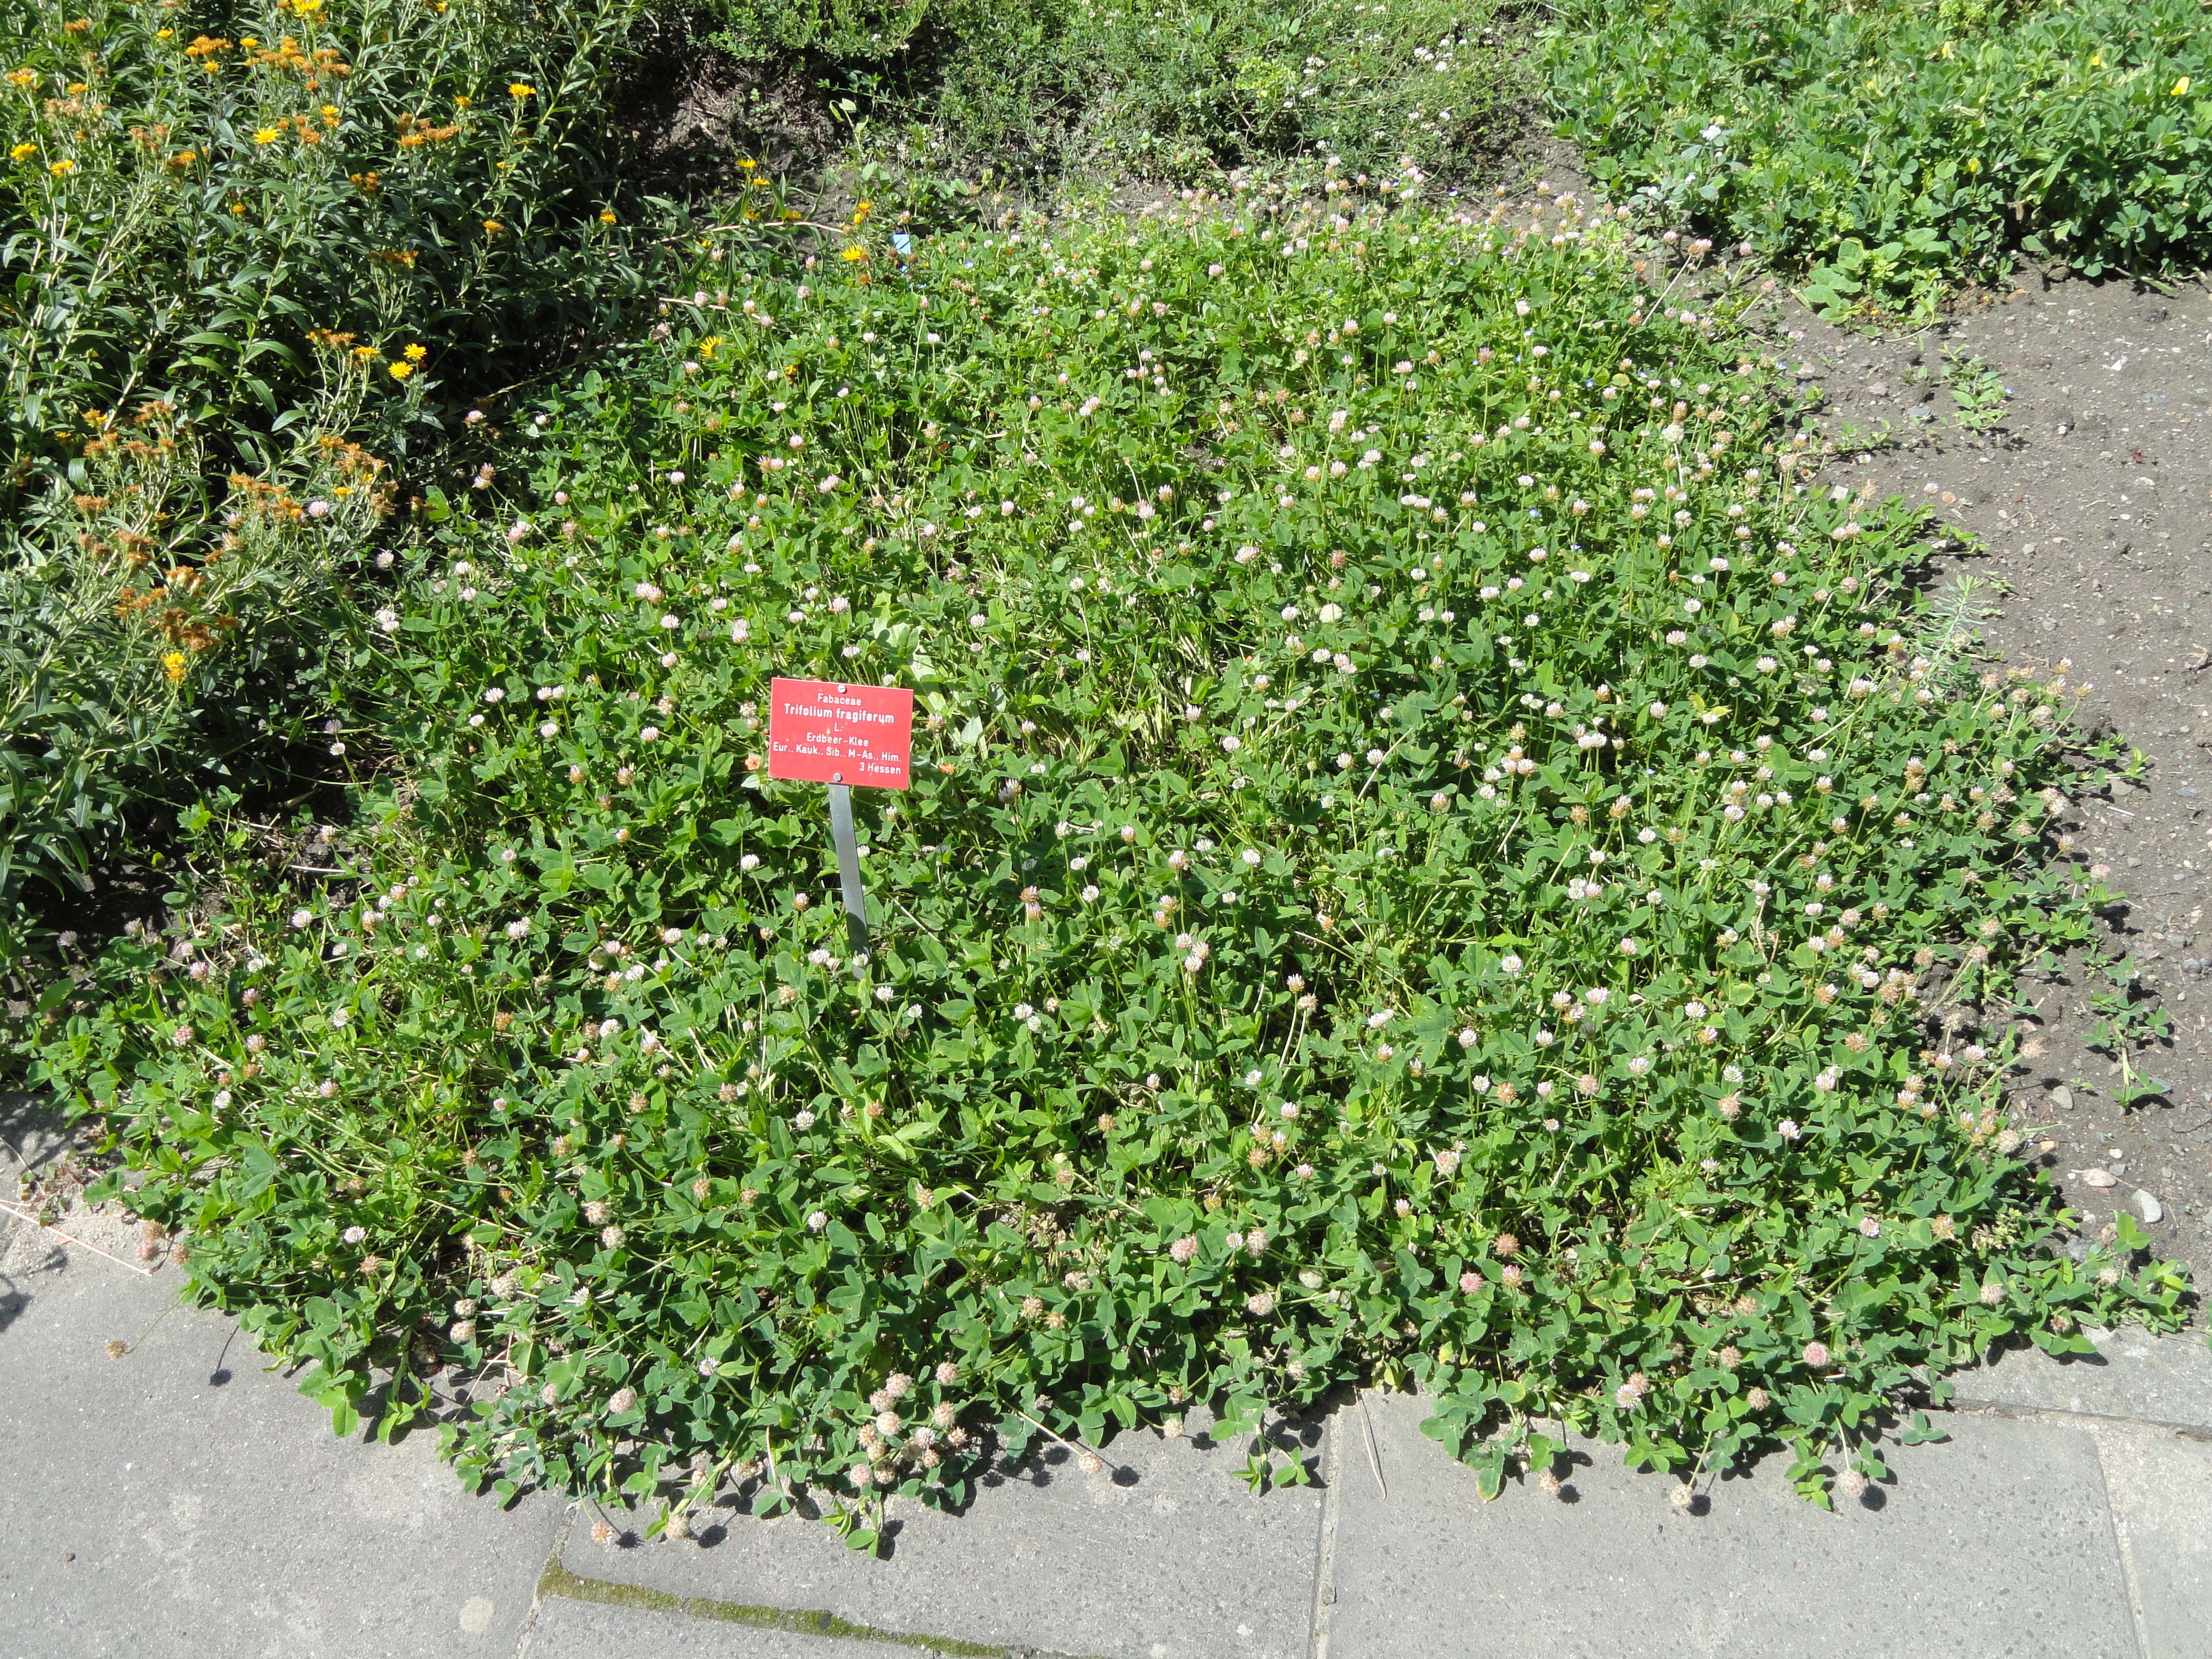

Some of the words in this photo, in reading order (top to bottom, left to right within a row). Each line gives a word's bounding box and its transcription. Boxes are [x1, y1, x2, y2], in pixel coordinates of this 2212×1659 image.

[818, 693, 861, 706] Fabaceae
[784, 703, 832, 718] Trifolium
[836, 708, 895, 723] fragiferum
[834, 722, 842, 732] L.
[807, 732, 869, 747] Erdbeer-Klee
[860, 762, 865, 771] 3
[868, 763, 901, 774] Hessen
